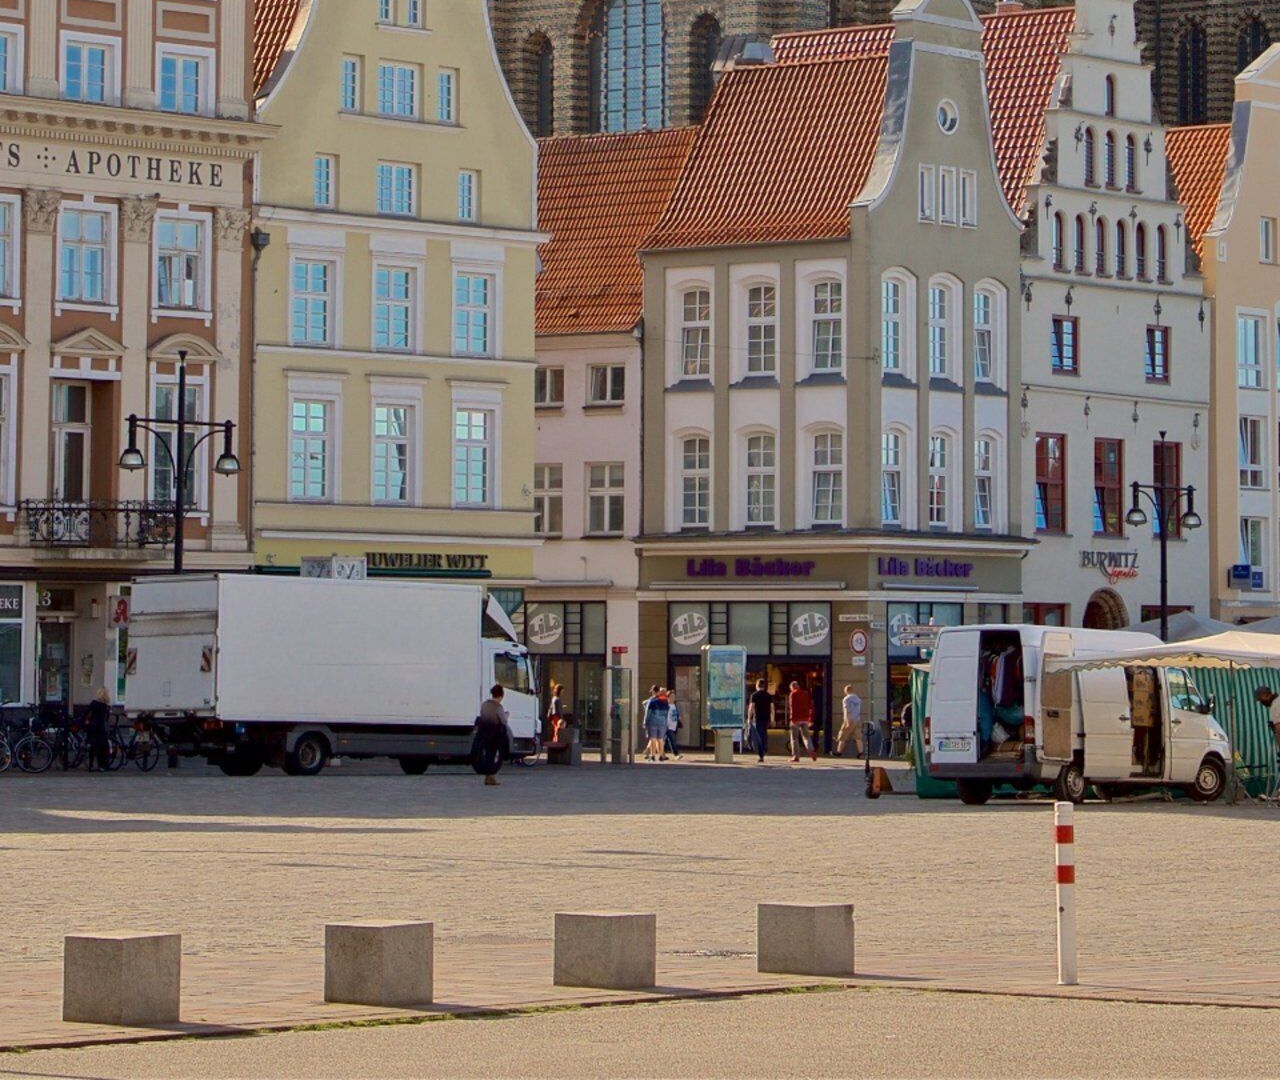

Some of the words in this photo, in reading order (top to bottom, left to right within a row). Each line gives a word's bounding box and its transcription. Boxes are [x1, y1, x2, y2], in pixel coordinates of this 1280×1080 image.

[65, 149, 224, 188] APOTHEKE
[446, 554, 488, 569] WITT
[686, 558, 727, 577] Lila
[735, 555, 815, 577] Bäcker
[877, 556, 910, 576] Lila
[914, 557, 974, 578] Bäcker
